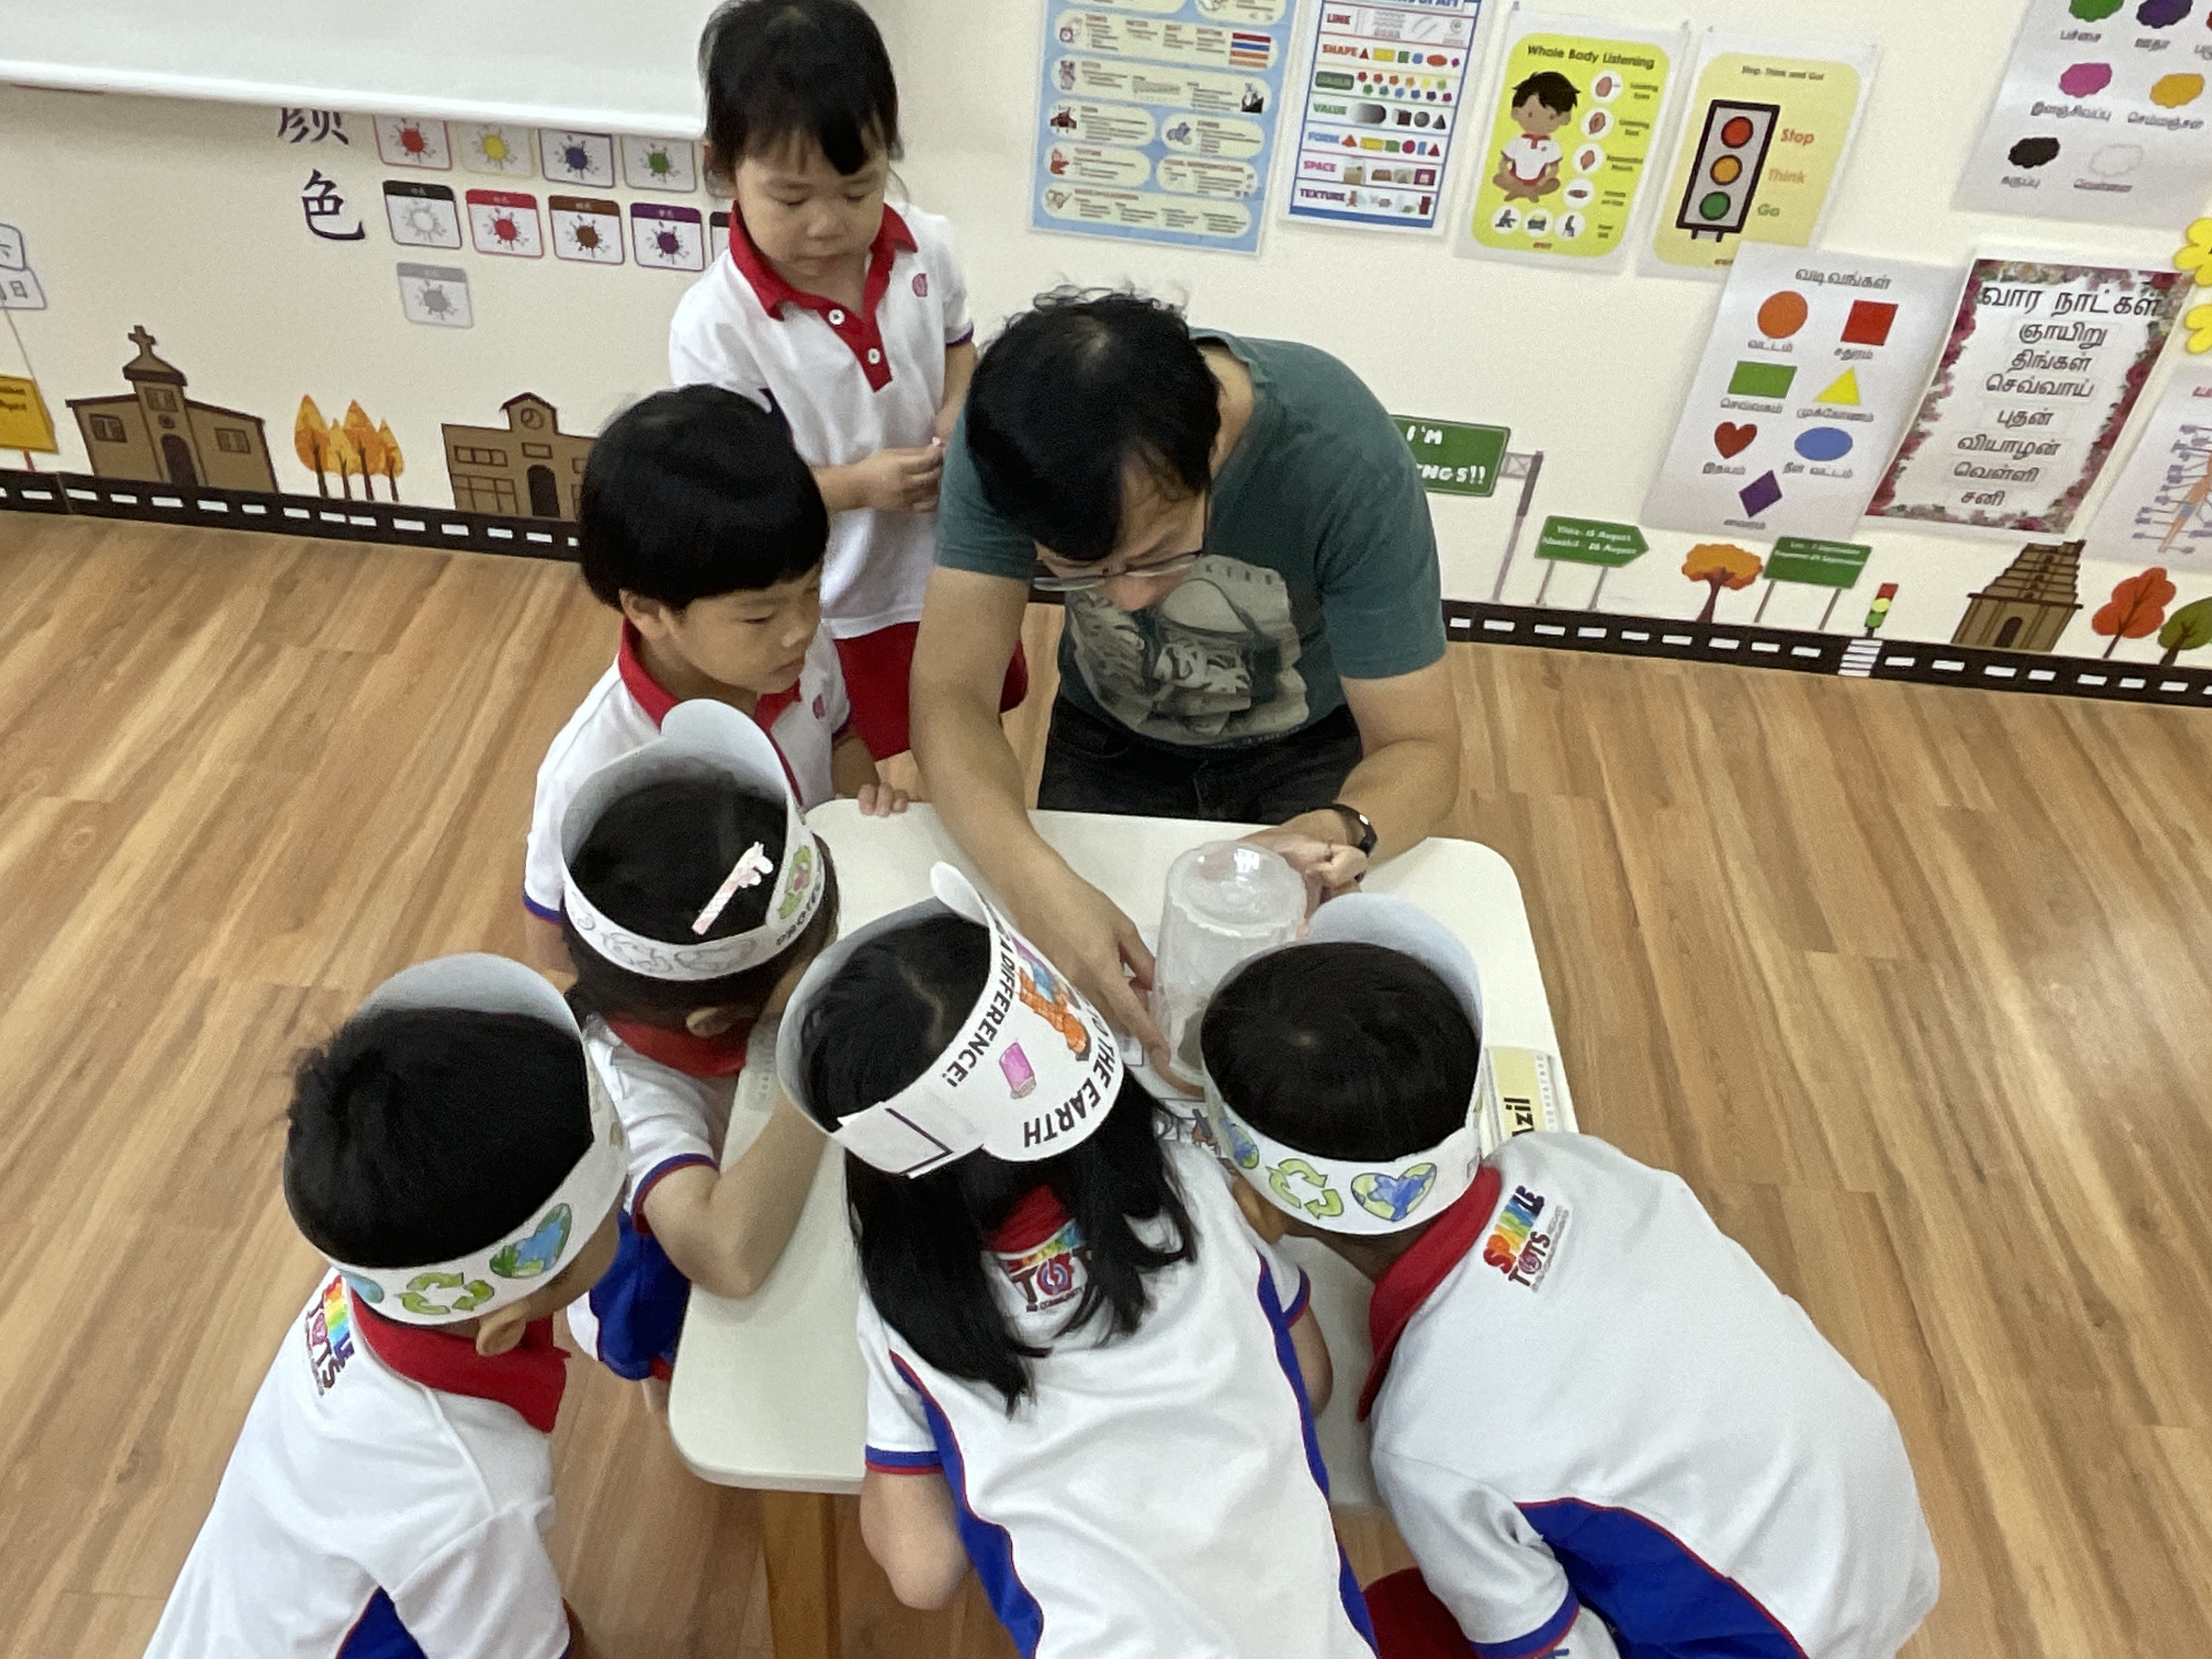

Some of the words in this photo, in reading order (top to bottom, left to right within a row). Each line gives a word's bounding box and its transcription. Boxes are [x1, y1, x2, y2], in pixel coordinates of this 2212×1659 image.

[1528, 45, 1564, 58] Whole
[1568, 49, 1599, 63] Body
[1602, 53, 1654, 70] Listening
[1780, 128, 1815, 146] Stop
[1768, 168, 1805, 185] Think
[1757, 204, 1780, 217] Go
[1982, 286, 2044, 314] வார
[2051, 288, 2163, 317] நாட்கள்
[2019, 321, 2108, 350] ஞாயிறு
[2005, 349, 2093, 374] திங்கள்
[1985, 373, 2095, 397] செவ்வாய்
[1997, 407, 2055, 429] புதன்
[1957, 433, 2062, 461] வியாழன்
[1416, 463, 1486, 485] NGS!!
[1953, 461, 2040, 482] வெள்ளி
[1960, 490, 2006, 506] சனி
[942, 951, 1015, 1088] DIFFERENCE!
[1093, 1036, 1116, 1089] THE
[1023, 1077, 1102, 1148] EARTH
